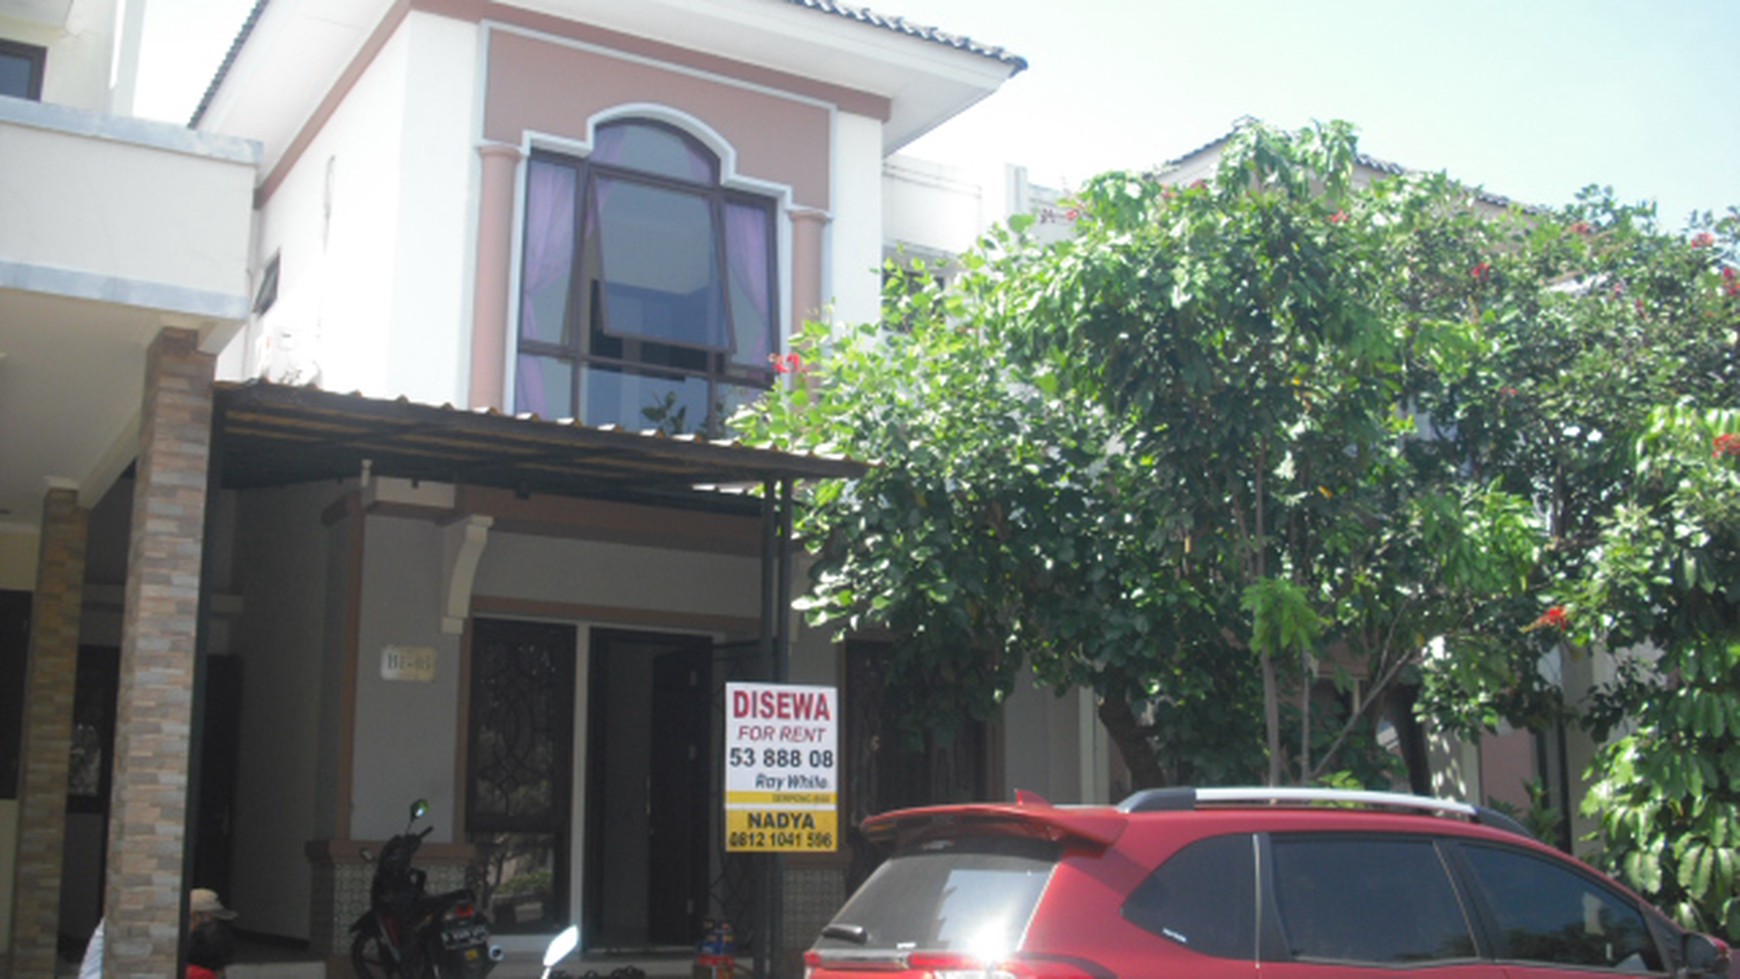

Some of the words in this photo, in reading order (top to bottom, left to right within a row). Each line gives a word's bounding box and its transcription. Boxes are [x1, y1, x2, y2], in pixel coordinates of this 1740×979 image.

[733, 690, 830, 720] DISEWA
[738, 725, 775, 741] FOR
[780, 725, 826, 742] RENT
[730, 747, 755, 767] 53
[763, 748, 801, 768] 888
[809, 749, 833, 768] 08
[755, 773, 785, 791] Ray
[787, 774, 828, 789] White
[747, 812, 815, 830] NADYA
[769, 832, 801, 848] 1041
